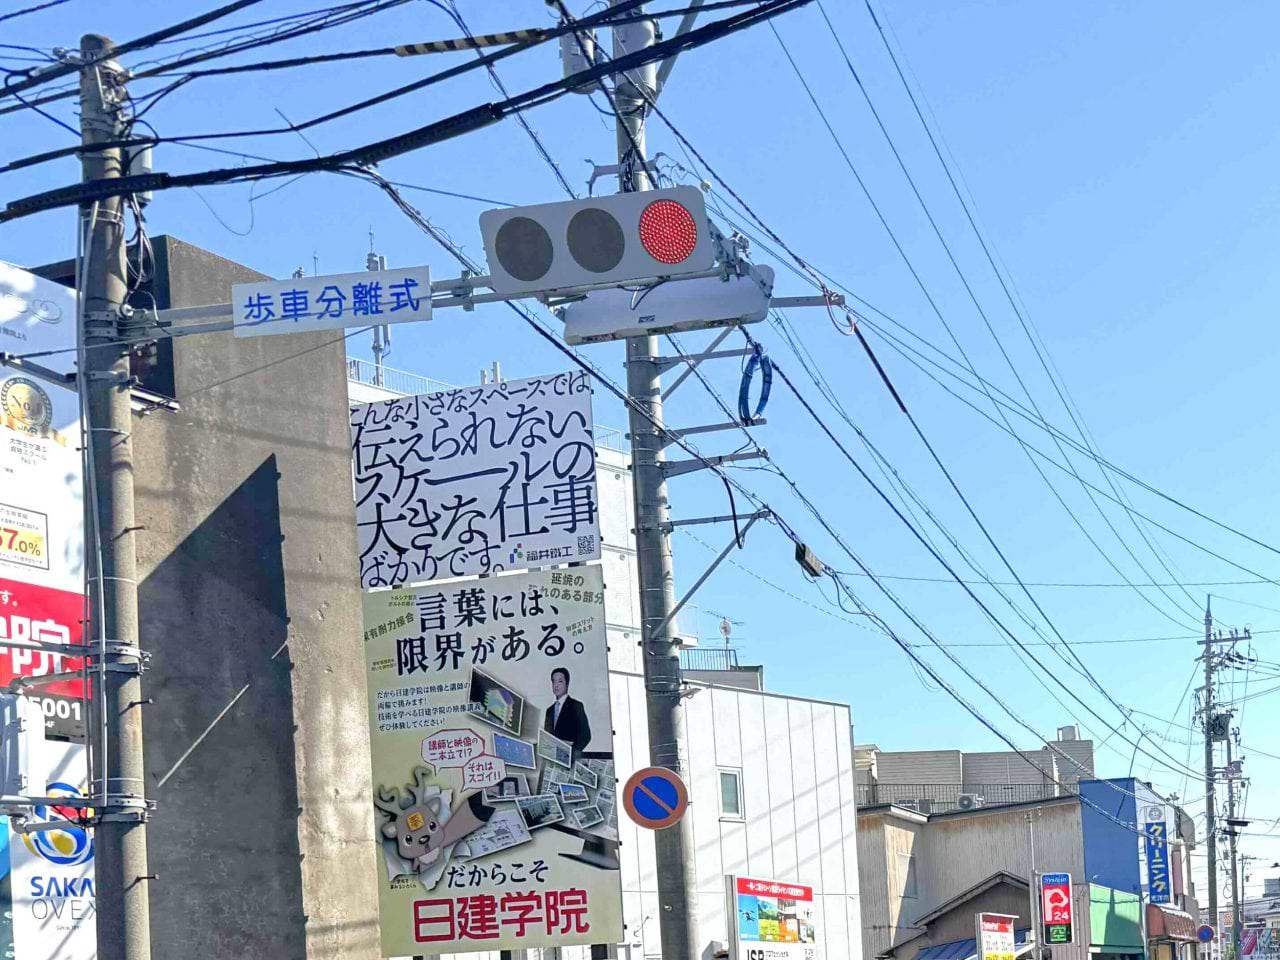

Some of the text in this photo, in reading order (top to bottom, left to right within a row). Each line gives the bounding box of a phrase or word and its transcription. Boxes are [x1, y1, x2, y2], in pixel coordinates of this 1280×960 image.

[243, 277, 421, 322] 歩車分離式
[355, 441, 596, 508] スケールの
[356, 475, 596, 558] 大きな仕事
[359, 539, 504, 588] ばかりです。
[416, 587, 559, 633] 言葉には、
[396, 622, 584, 676] 限界がある。
[29, 696, 82, 721] 001
[468, 761, 494, 772] それは
[447, 859, 549, 889] だからこそ
[1149, 824, 1166, 893] クリーニング
[413, 887, 591, 943] 日建学院
[1053, 911, 1069, 920] 24
